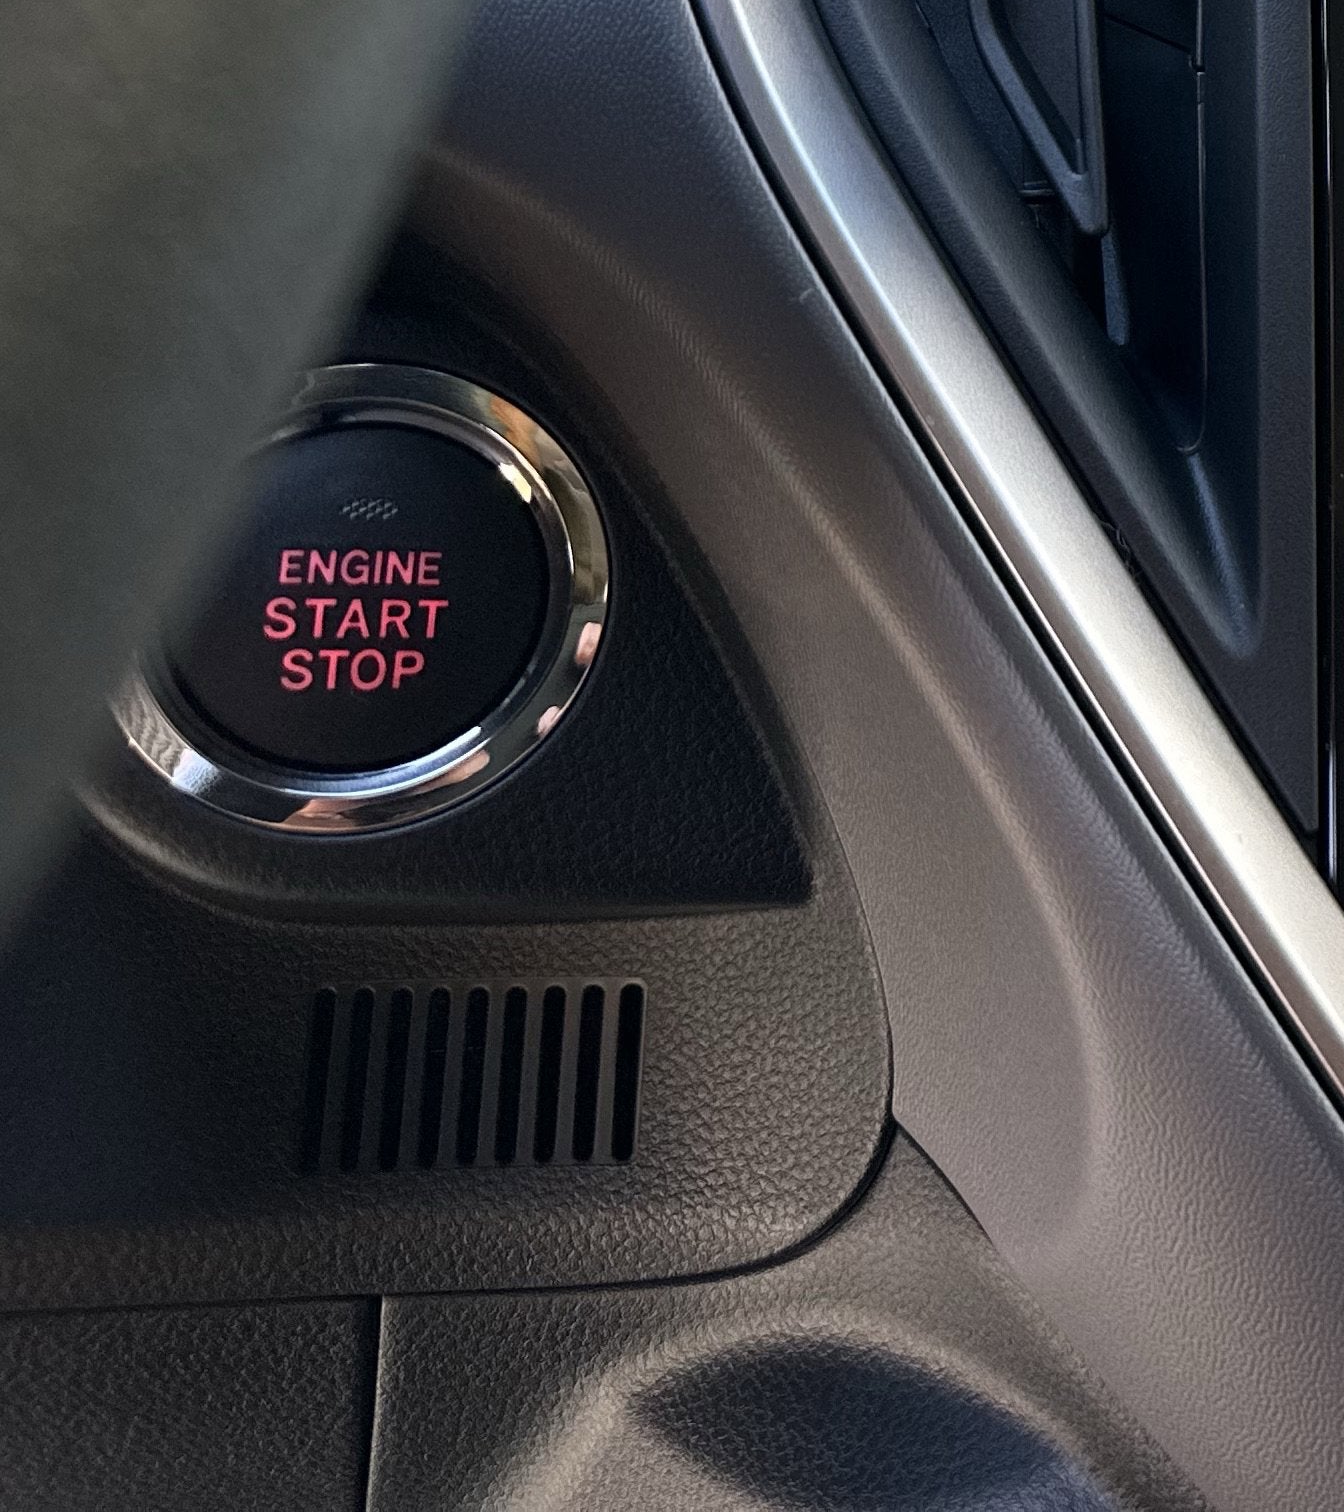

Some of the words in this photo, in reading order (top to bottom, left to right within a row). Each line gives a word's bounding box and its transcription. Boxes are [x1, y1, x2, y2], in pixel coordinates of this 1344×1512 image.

[278, 548, 443, 586] ENGINE
[262, 596, 449, 640] START
[280, 648, 425, 691] STOP
